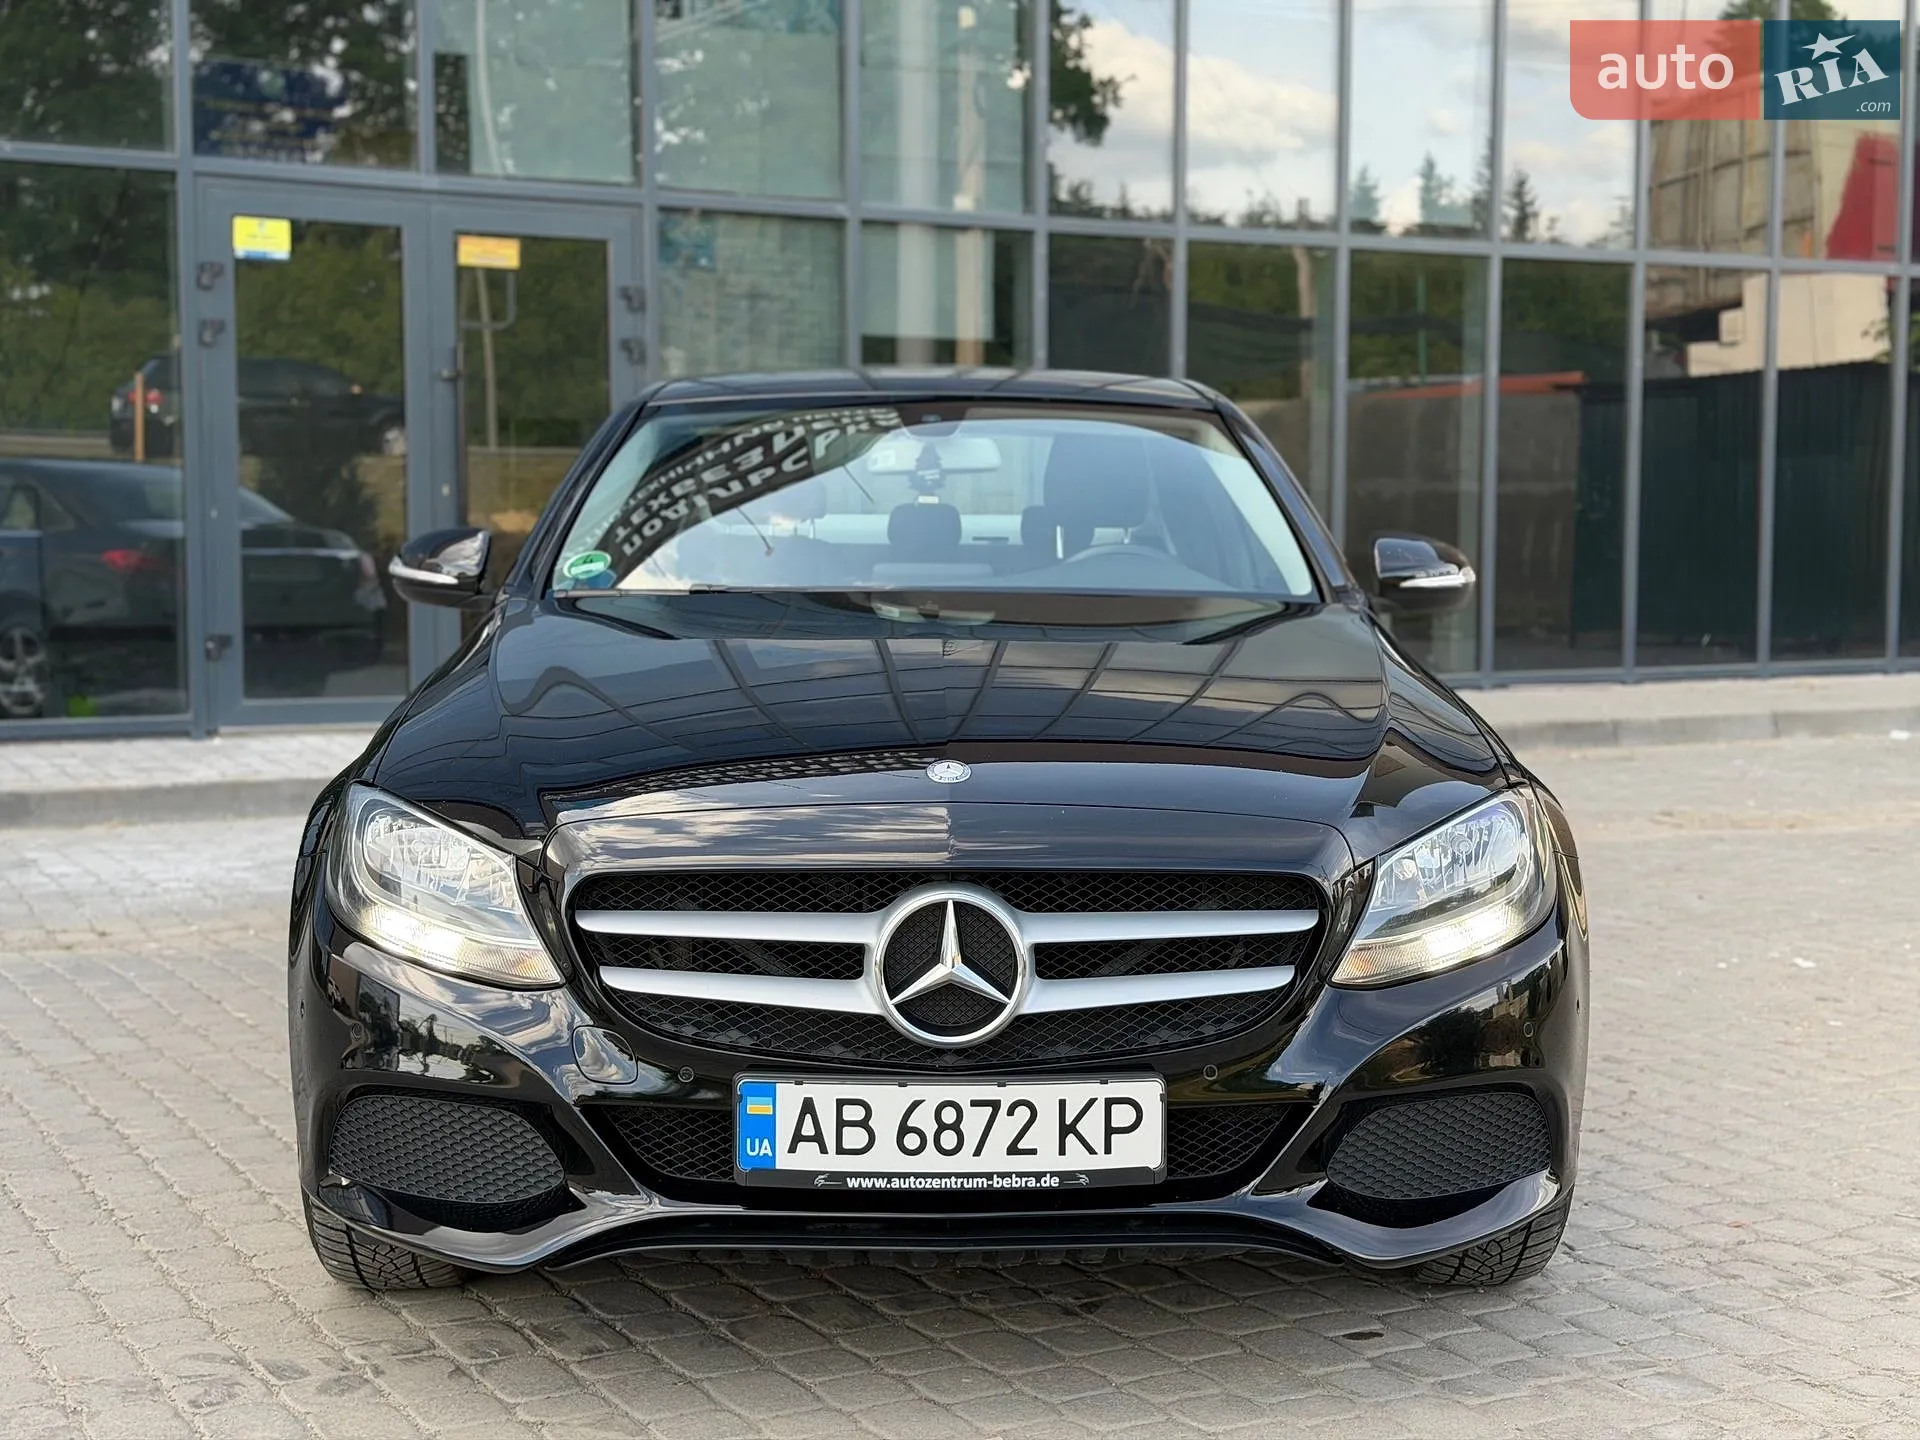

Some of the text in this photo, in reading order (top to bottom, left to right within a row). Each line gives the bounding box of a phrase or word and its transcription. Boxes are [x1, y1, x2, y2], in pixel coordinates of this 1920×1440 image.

[787, 1097, 1144, 1157] AB 6872 KP
[747, 1138, 773, 1156] UA
[846, 1173, 1060, 1190] www.autozentrum-bebra.de
